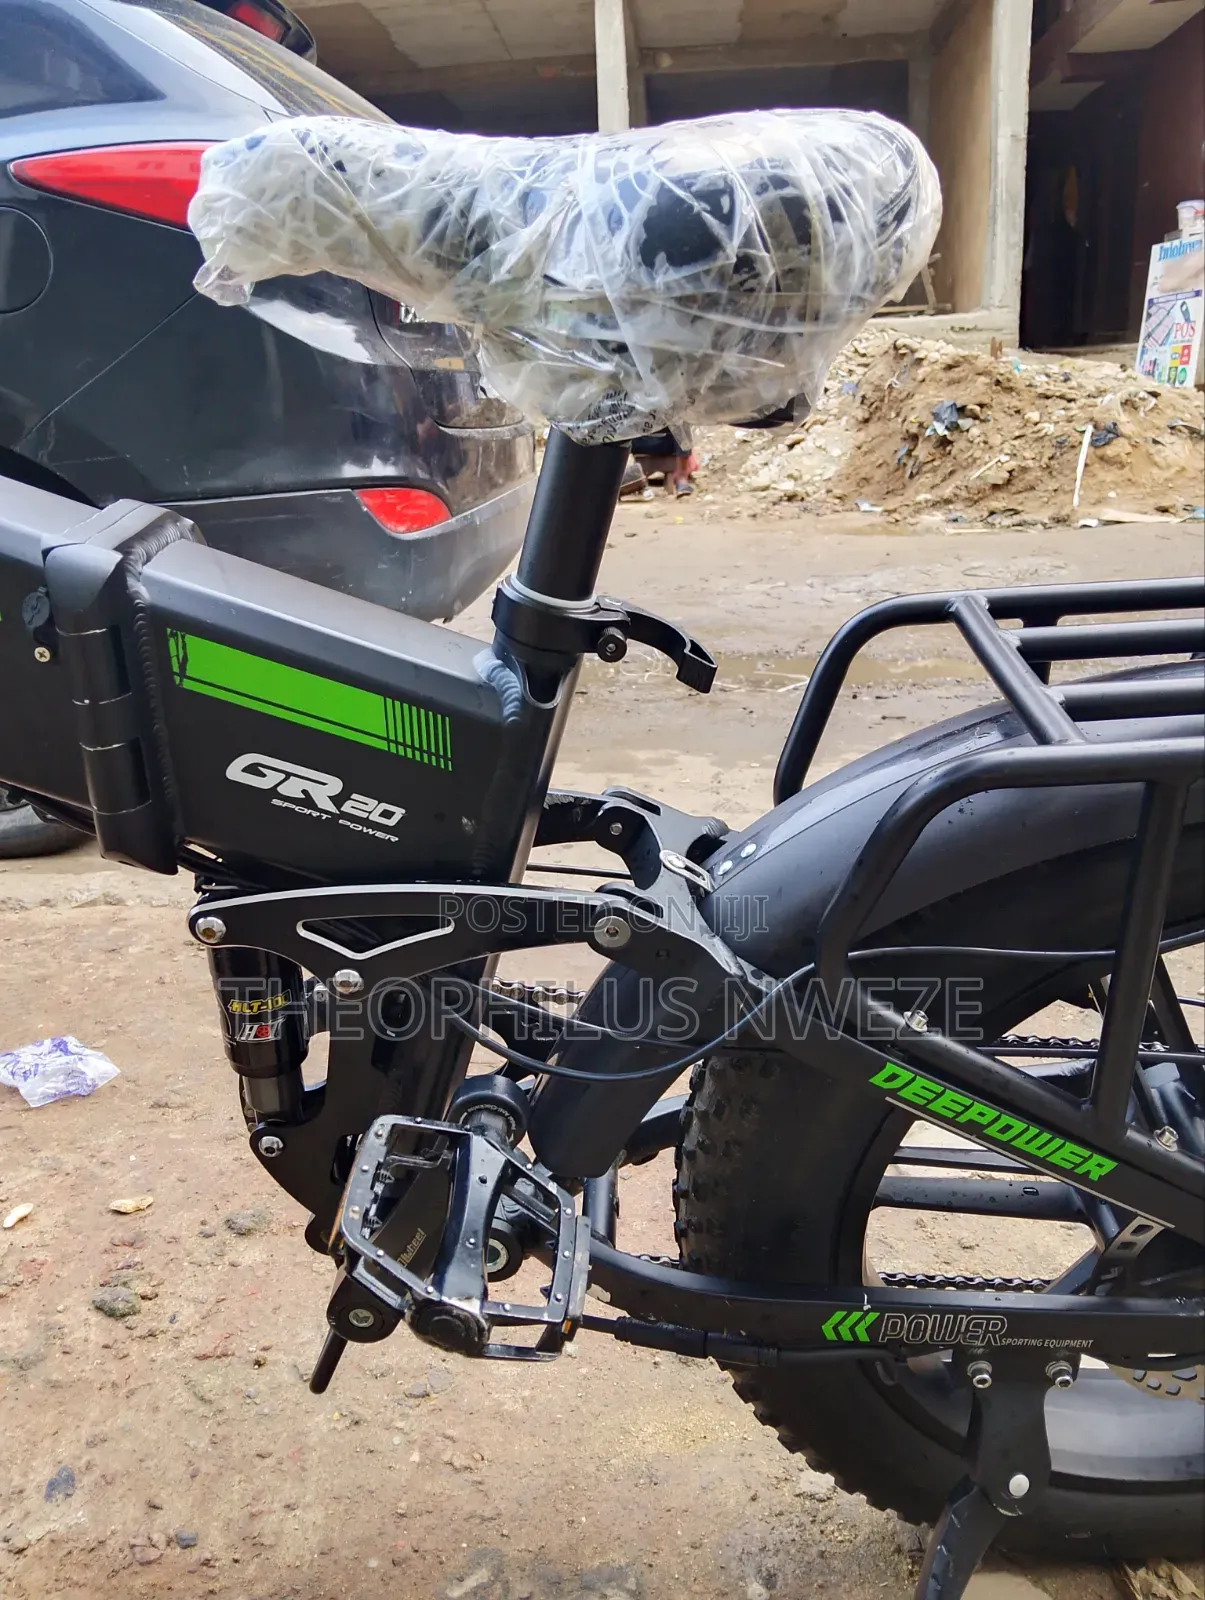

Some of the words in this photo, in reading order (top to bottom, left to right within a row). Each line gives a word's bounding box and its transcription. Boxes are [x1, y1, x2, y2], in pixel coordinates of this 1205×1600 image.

[1174, 320, 1196, 339] POS
[225, 753, 344, 814] GR
[340, 793, 406, 826] 20
[270, 798, 332, 820] SPORT
[338, 819, 400, 842] POWER
[868, 1061, 1118, 1182] DEEPOWER
[879, 1313, 1007, 1346] POWER
[1000, 1337, 1043, 1347] SPORTING
[1043, 1338, 1094, 1348] EQUIPMENT
